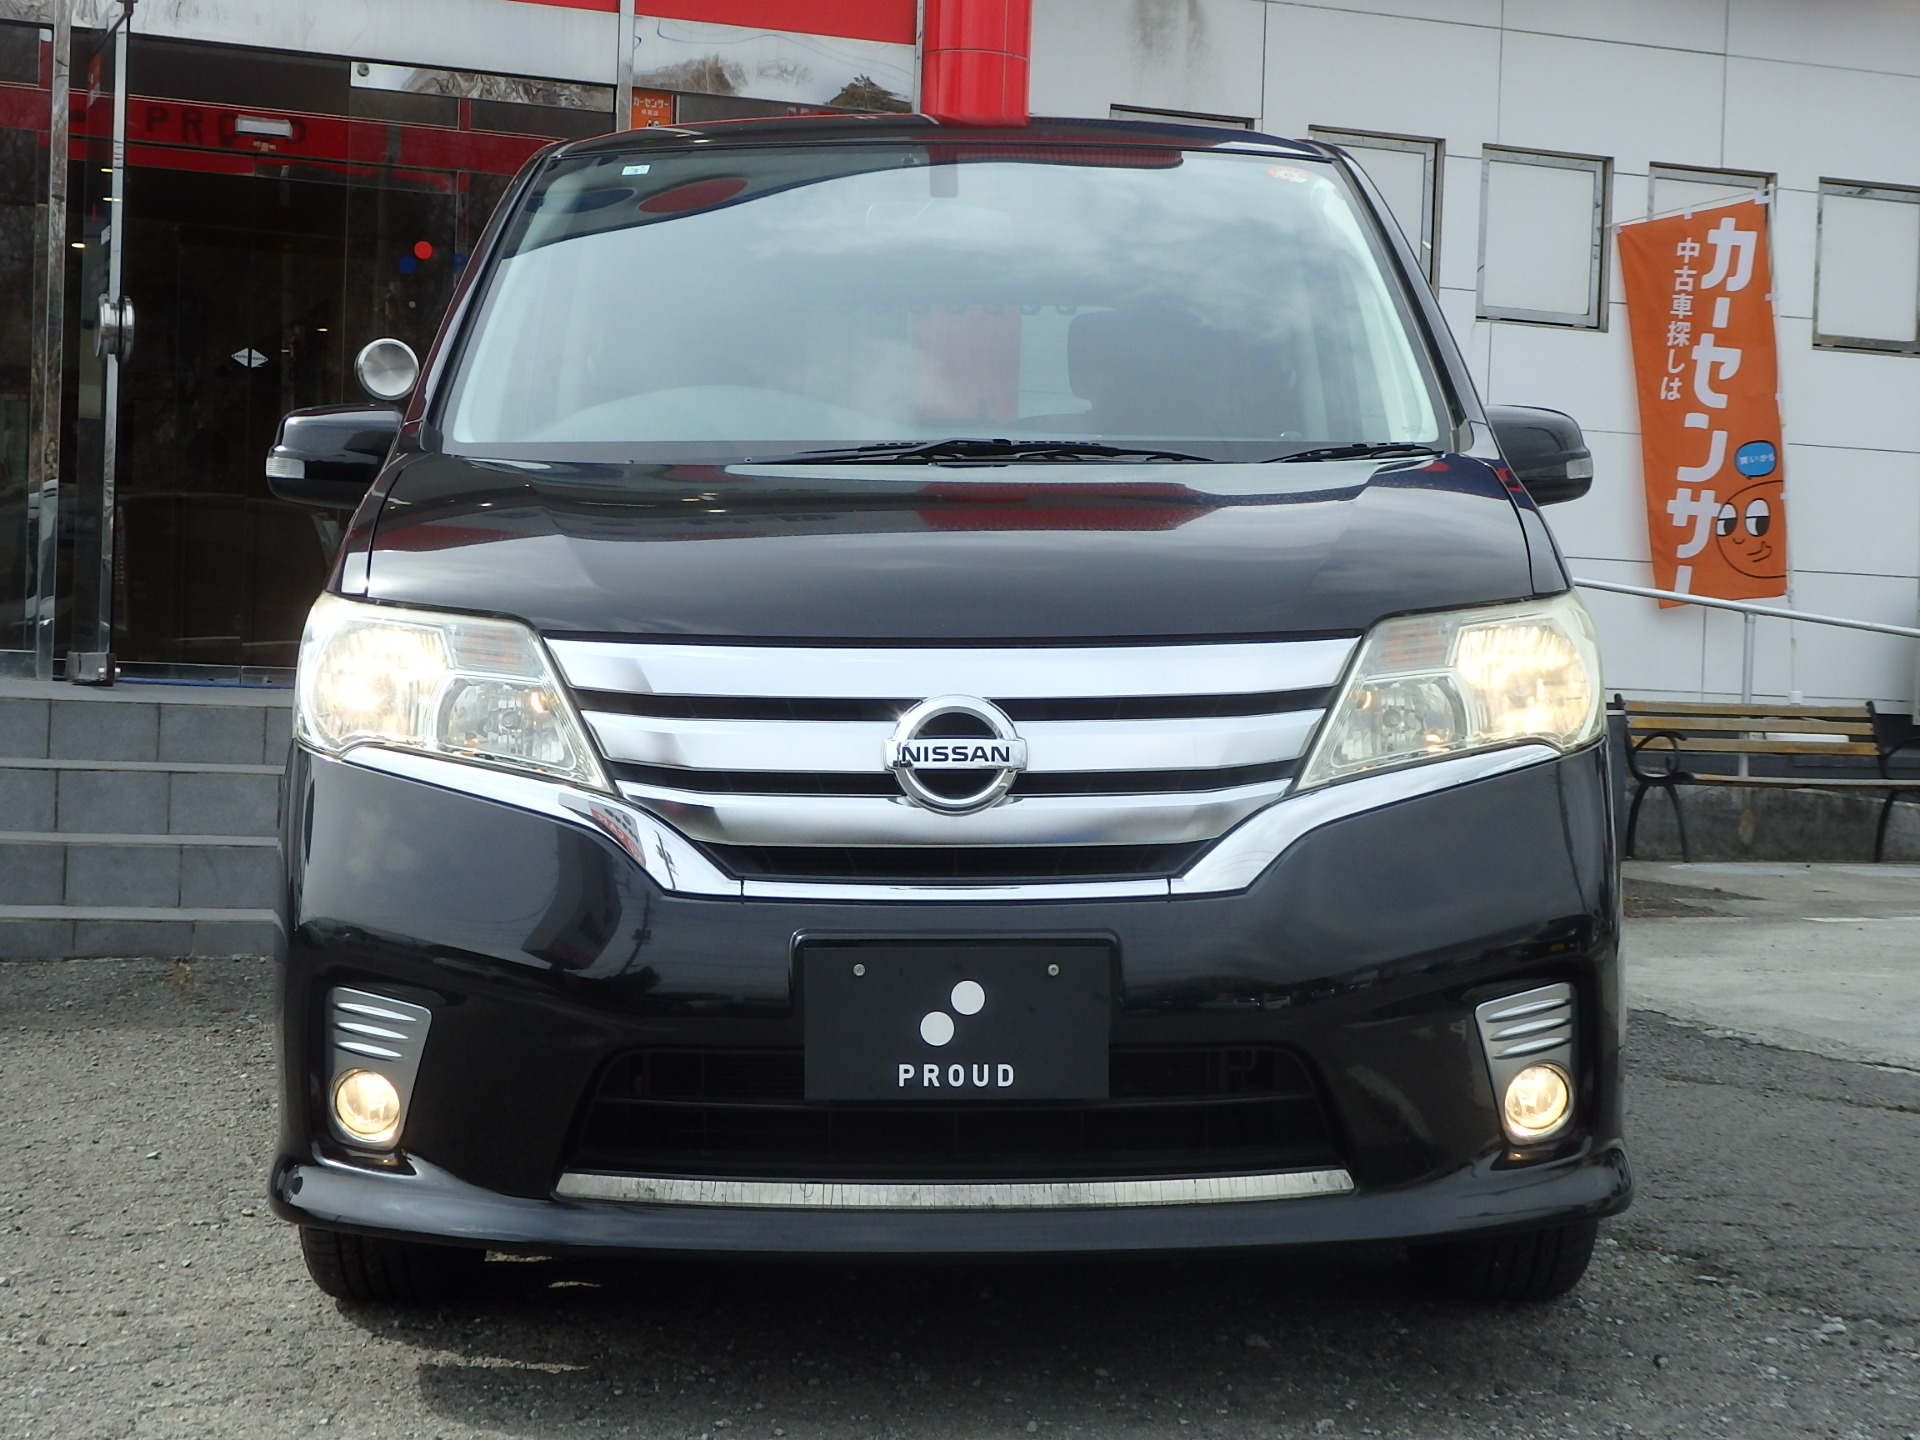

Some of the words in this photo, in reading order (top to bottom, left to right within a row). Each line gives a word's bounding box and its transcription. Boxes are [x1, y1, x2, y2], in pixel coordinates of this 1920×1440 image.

[1660, 237, 1701, 401] 中古車探しは
[1666, 217, 1758, 595] カーセンサー
[901, 746, 1010, 763] NISSAN
[898, 1063, 1015, 1087] PROUD
